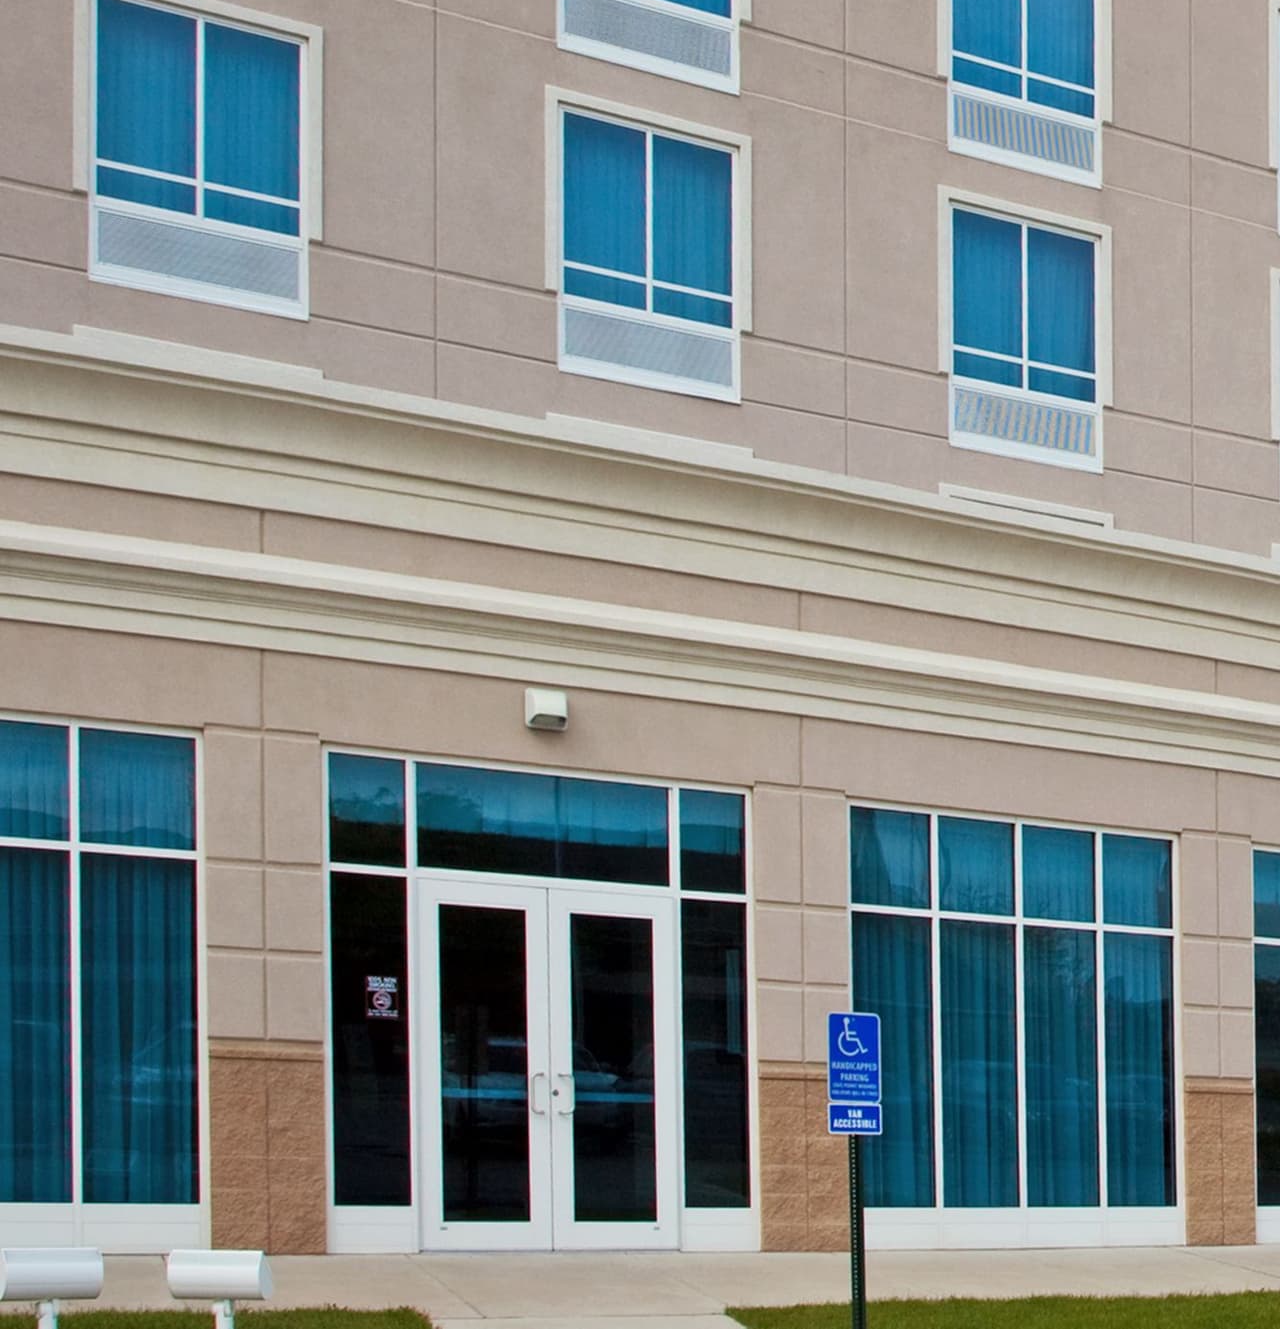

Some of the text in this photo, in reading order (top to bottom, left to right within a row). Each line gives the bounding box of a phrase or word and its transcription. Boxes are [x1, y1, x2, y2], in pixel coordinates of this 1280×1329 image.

[831, 1061, 877, 1071] HANDICAPPED
[840, 1073, 869, 1082] PARKING
[847, 1109, 862, 1118] VAN
[833, 1118, 877, 1128] ACCESSIBLE
